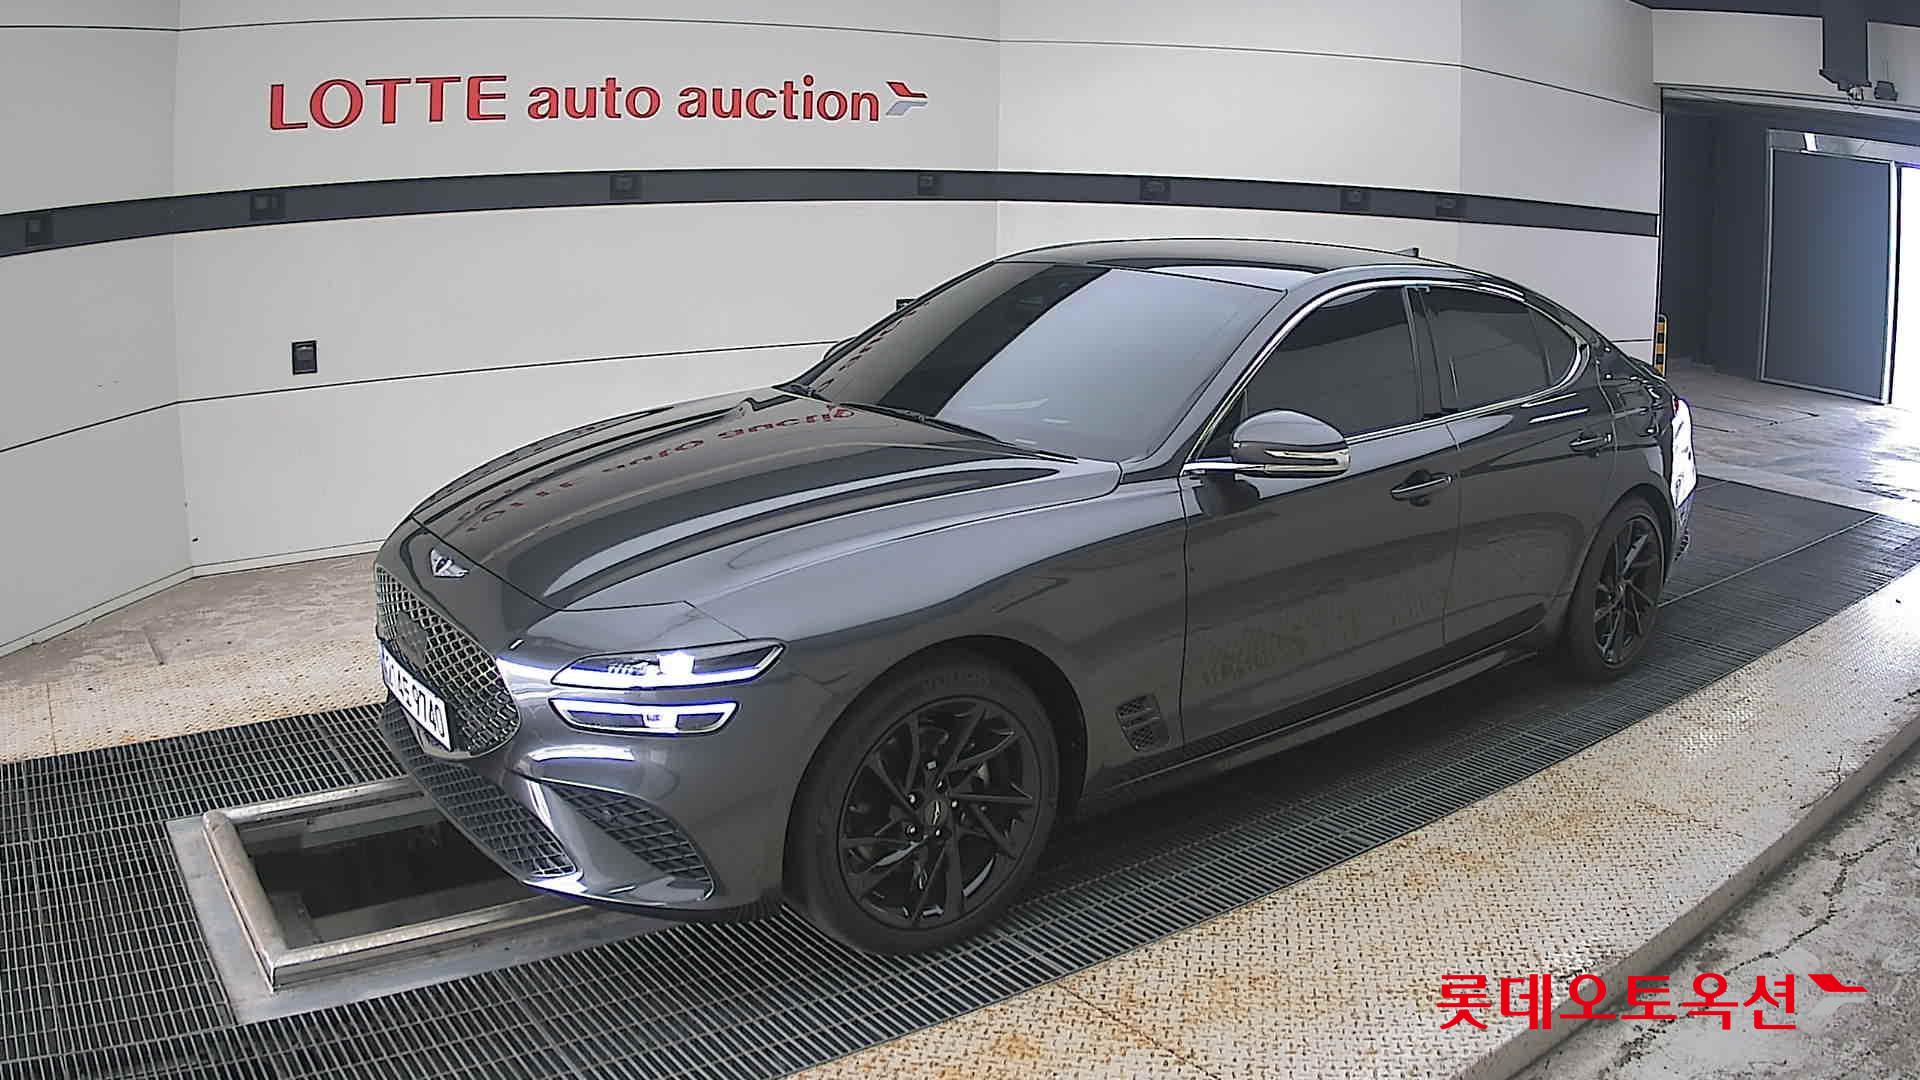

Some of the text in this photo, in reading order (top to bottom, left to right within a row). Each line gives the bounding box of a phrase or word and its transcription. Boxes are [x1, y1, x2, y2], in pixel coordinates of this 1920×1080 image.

[268, 74, 880, 131] LOTTE auto auction
